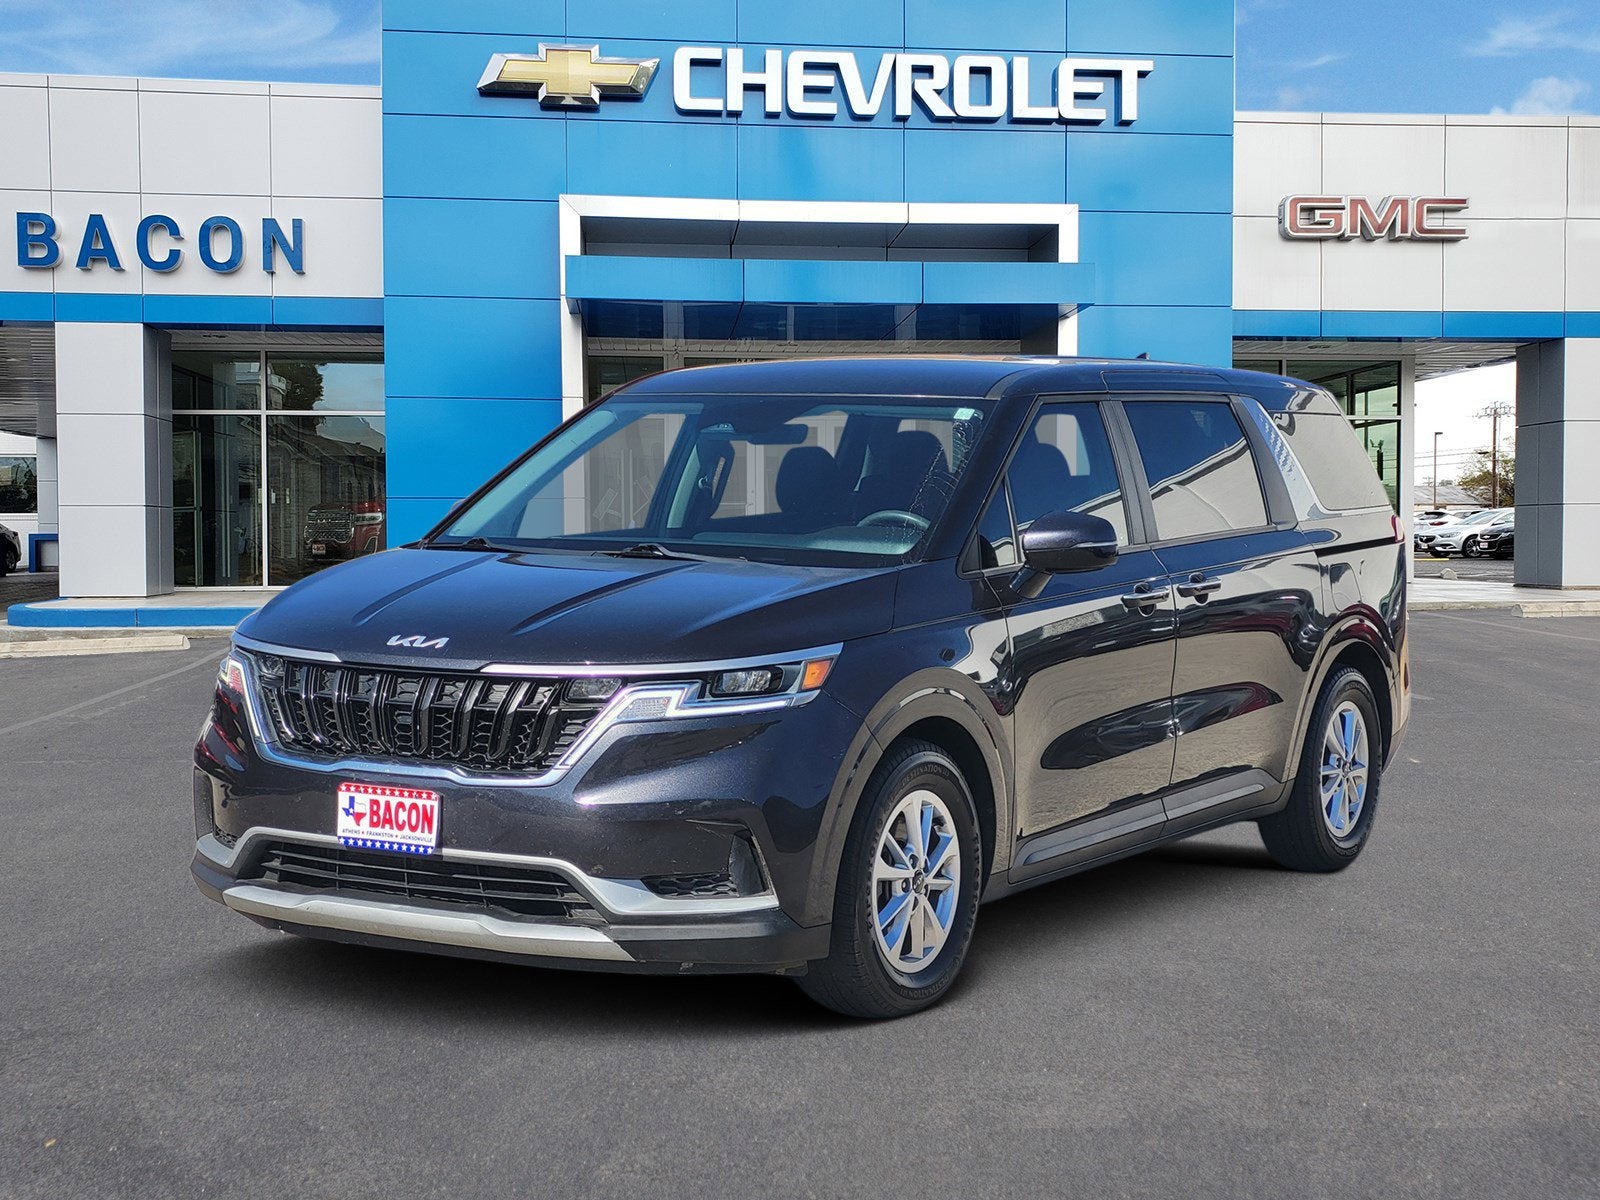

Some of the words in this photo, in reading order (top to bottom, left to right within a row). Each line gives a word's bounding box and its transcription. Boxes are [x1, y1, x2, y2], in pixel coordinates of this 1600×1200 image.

[673, 46, 1154, 123] CHEVROLET
[16, 211, 306, 275] BACON
[1278, 194, 1469, 241] GMC
[369, 798, 434, 834] BACON
